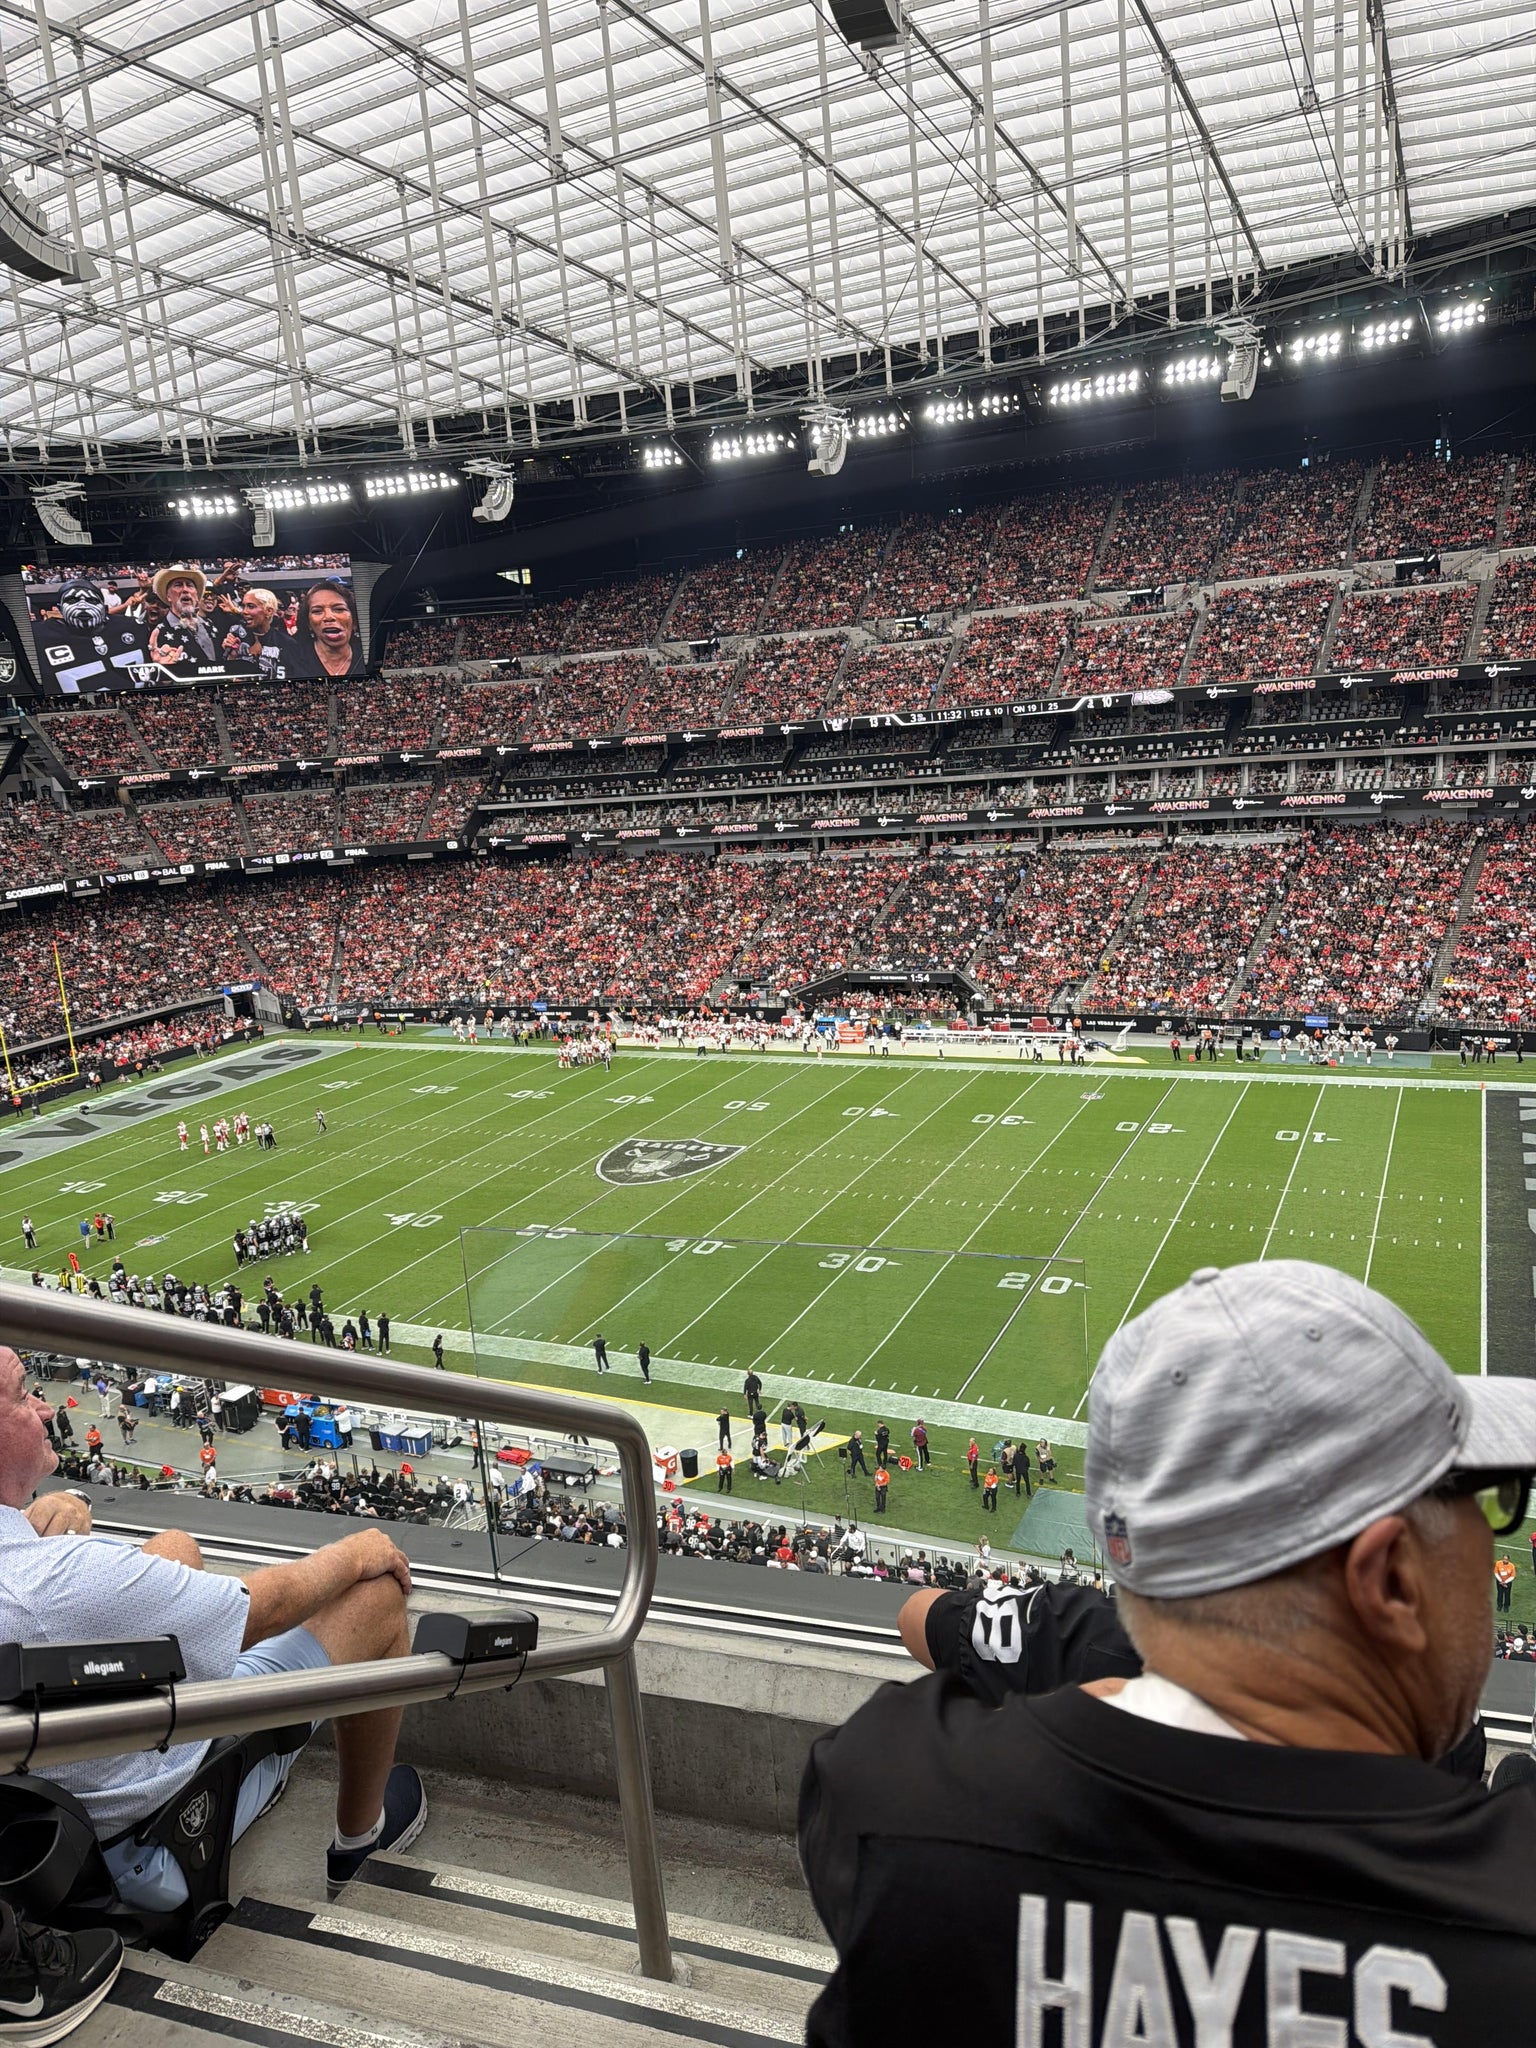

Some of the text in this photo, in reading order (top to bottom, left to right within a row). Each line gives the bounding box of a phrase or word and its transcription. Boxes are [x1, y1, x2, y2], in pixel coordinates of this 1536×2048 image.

[197, 665, 225, 674] MARK
[1252, 679, 1316, 695] AWAKENING
[1390, 668, 1459, 684] AWAKENING
[937, 710, 962, 720] 11:32
[970, 708, 984, 717] 1ST
[985, 708, 991, 716] &
[994, 707, 1003, 715] 10
[1012, 705, 1025, 713] ON
[1027, 704, 1037, 712] 19
[1048, 702, 1059, 710] 25
[1102, 696, 1112, 708] 10
[1027, 806, 1084, 819] AWAKENING
[1149, 800, 1210, 813] AWAKENING
[1280, 793, 1346, 807] AWAKENING
[1422, 788, 1494, 803] AWAKENING
[5, 882, 64, 900] SCOREBOARD
[75, 879, 92, 888] NFL
[116, 873, 133, 882] TEN
[162, 868, 179, 876] BAL
[205, 861, 230, 871] FINAL
[262, 856, 274, 865] NE
[303, 852, 319, 860] BUF
[345, 848, 368, 857] FINAL
[910, 973, 930, 982] 1:54
[12, 1048, 322, 1140] VEGAS
[634, 1141, 728, 1153] RAIDERS
[153, 1191, 208, 1204] 20
[389, 1212, 443, 1228] 40
[665, 1239, 723, 1255] 40
[818, 1253, 887, 1272] 30
[997, 1271, 1074, 1294] 20
[278, 1393, 288, 1404] G
[668, 1458, 676, 1469] G
[455, 1488, 462, 1499] 2
[83, 1660, 125, 1676] allegiant
[198, 1841, 206, 1861] 1
